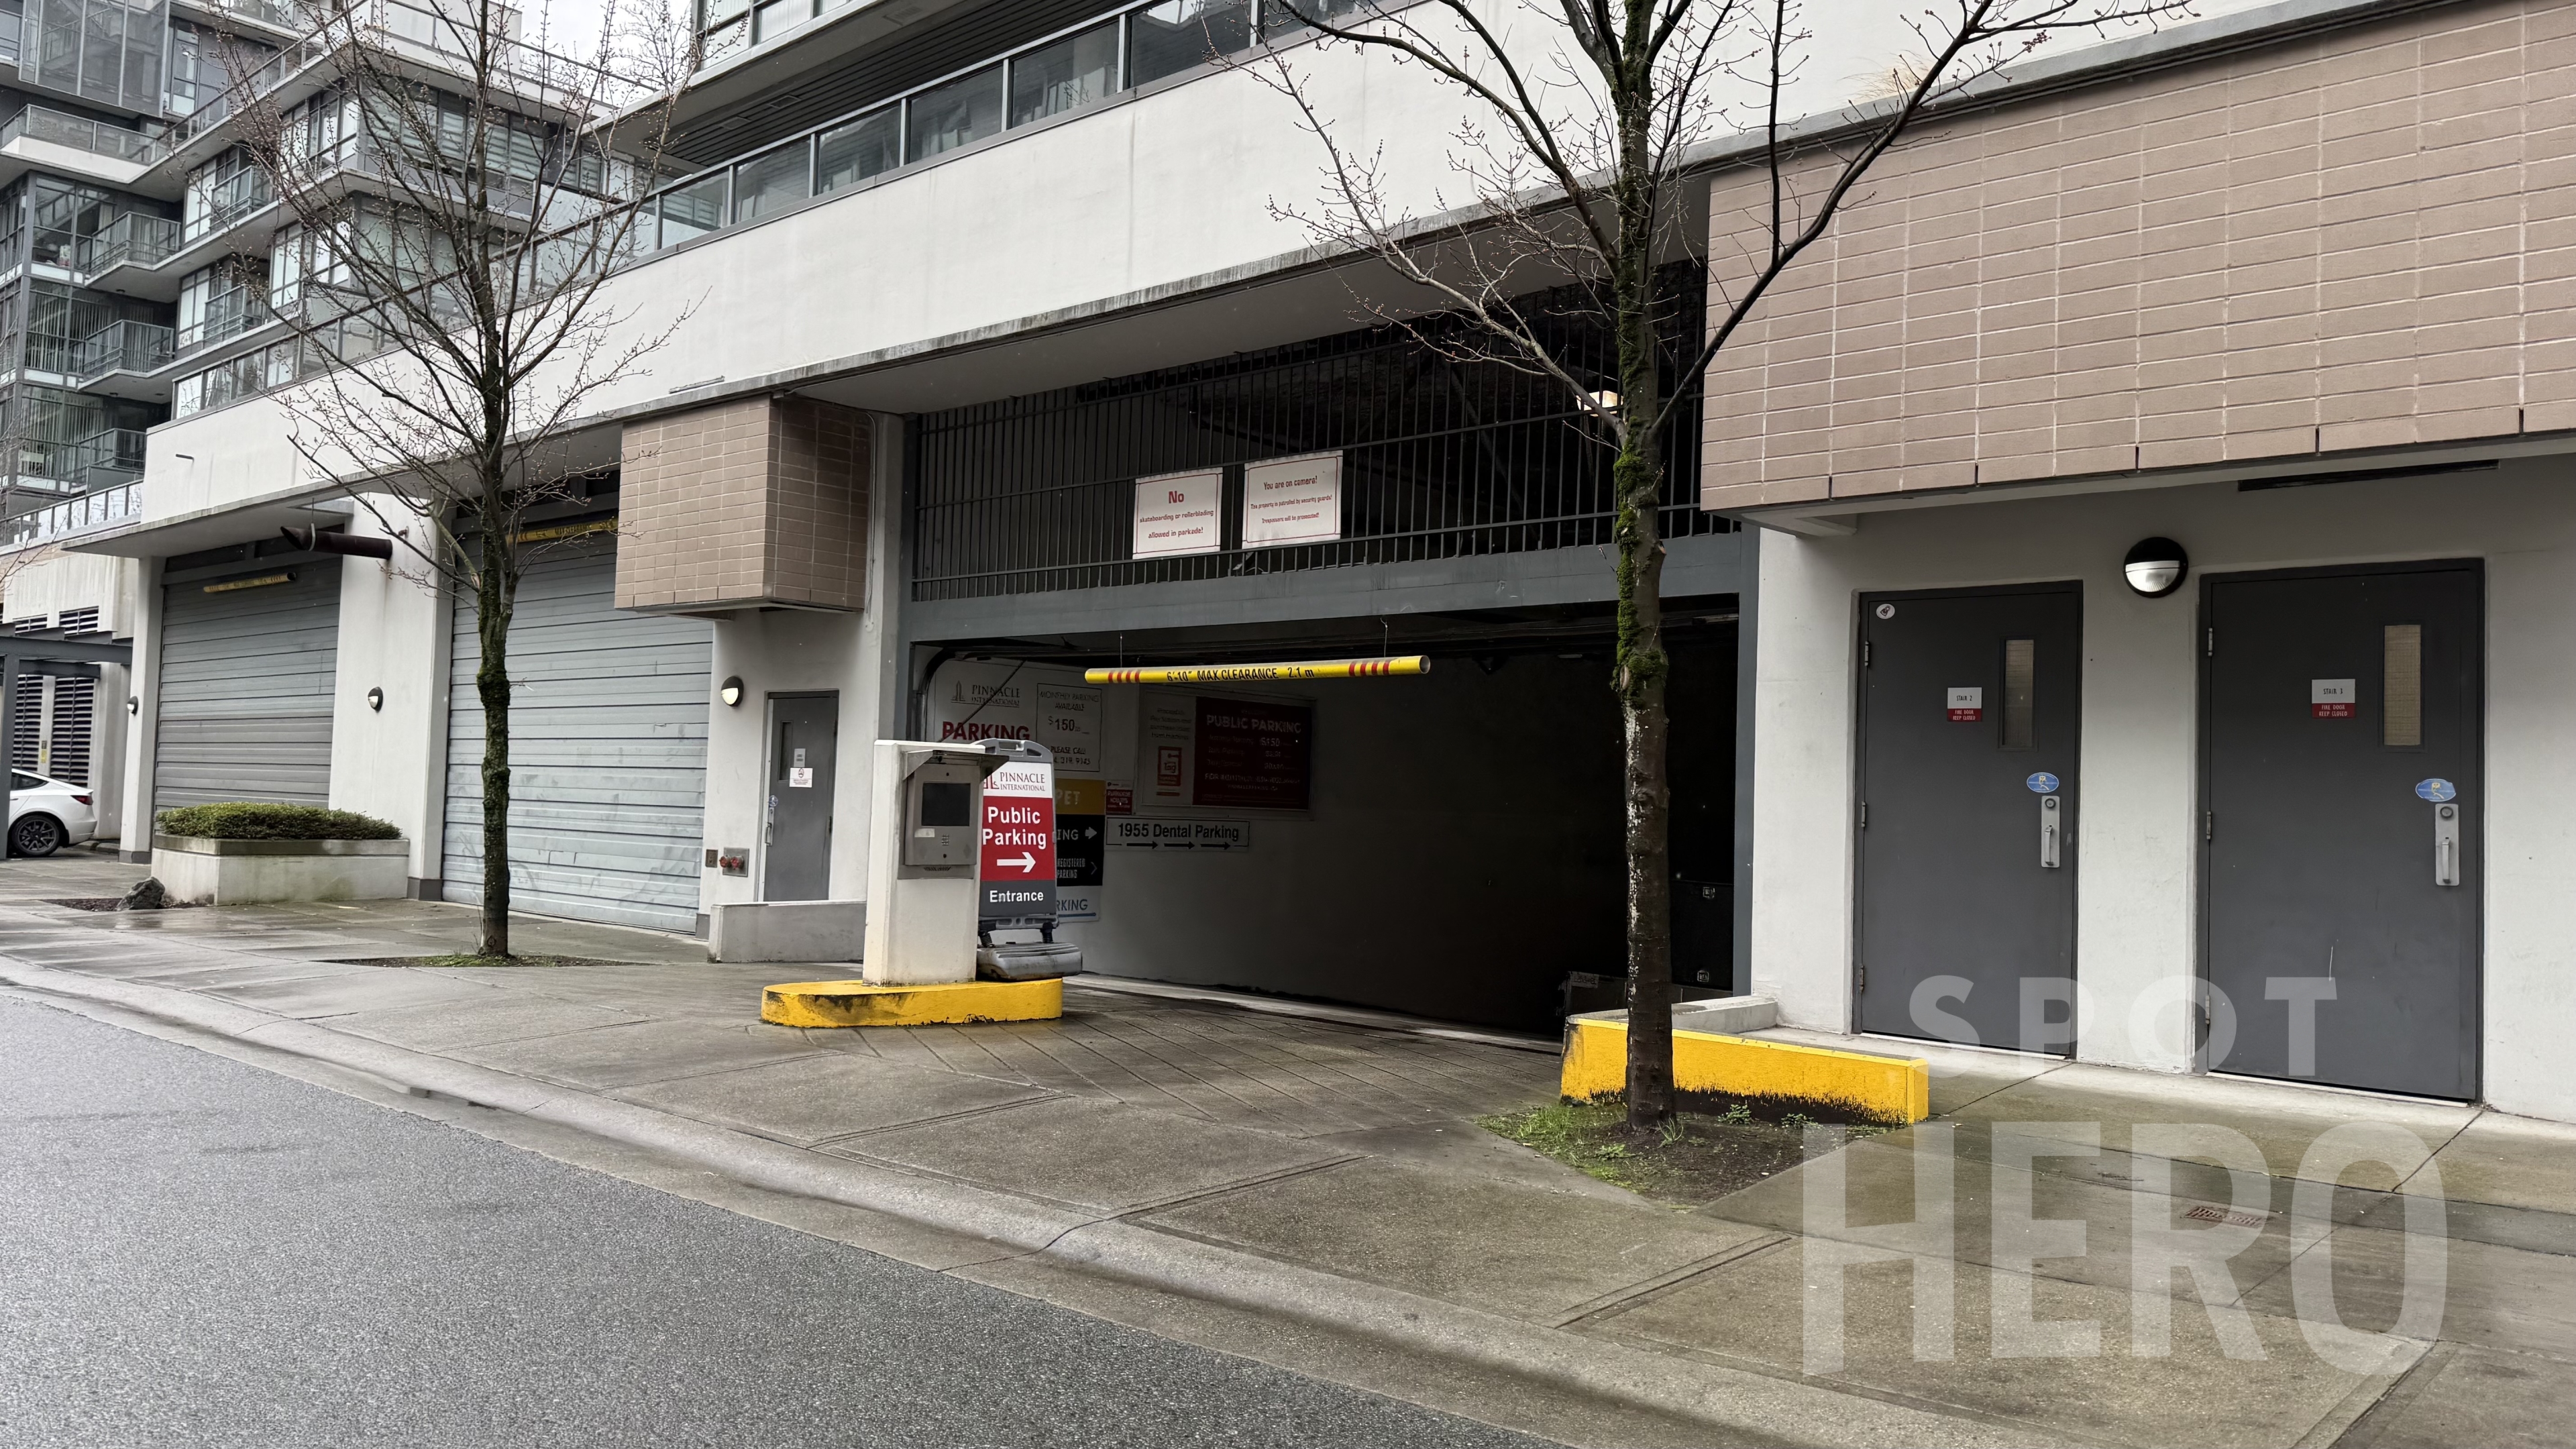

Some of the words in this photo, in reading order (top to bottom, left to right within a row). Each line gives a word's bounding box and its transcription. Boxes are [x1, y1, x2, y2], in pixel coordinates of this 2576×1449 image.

[1263, 482, 1273, 490] You
[1294, 475, 1318, 486] camera!
[1169, 490, 1185, 504] No
[1140, 514, 1174, 523] skateboarding
[1181, 509, 1214, 519] rollerblading
[1148, 531, 1170, 539] allowed
[1177, 527, 1203, 537] parkade!
[1197, 669, 1220, 682] MAX
[1221, 667, 1279, 680] CLEARANCE
[1287, 667, 1301, 678] 2.1
[1304, 669, 1314, 678] m
[971, 684, 1020, 698] PINNACLE
[943, 721, 1030, 741] PARKING
[1206, 714, 1248, 730] PUBLIC
[1251, 718, 1301, 734] PARKING
[1000, 772, 1045, 784] PINNACLE
[1000, 784, 1045, 792] INTERNATIONAL
[987, 806, 1040, 824] Public
[982, 828, 1046, 850] Parking
[1118, 822, 1148, 837] 1955
[1153, 823, 1191, 838] Dental
[1195, 824, 1239, 842] Parking
[989, 890, 1044, 903] Entrance
